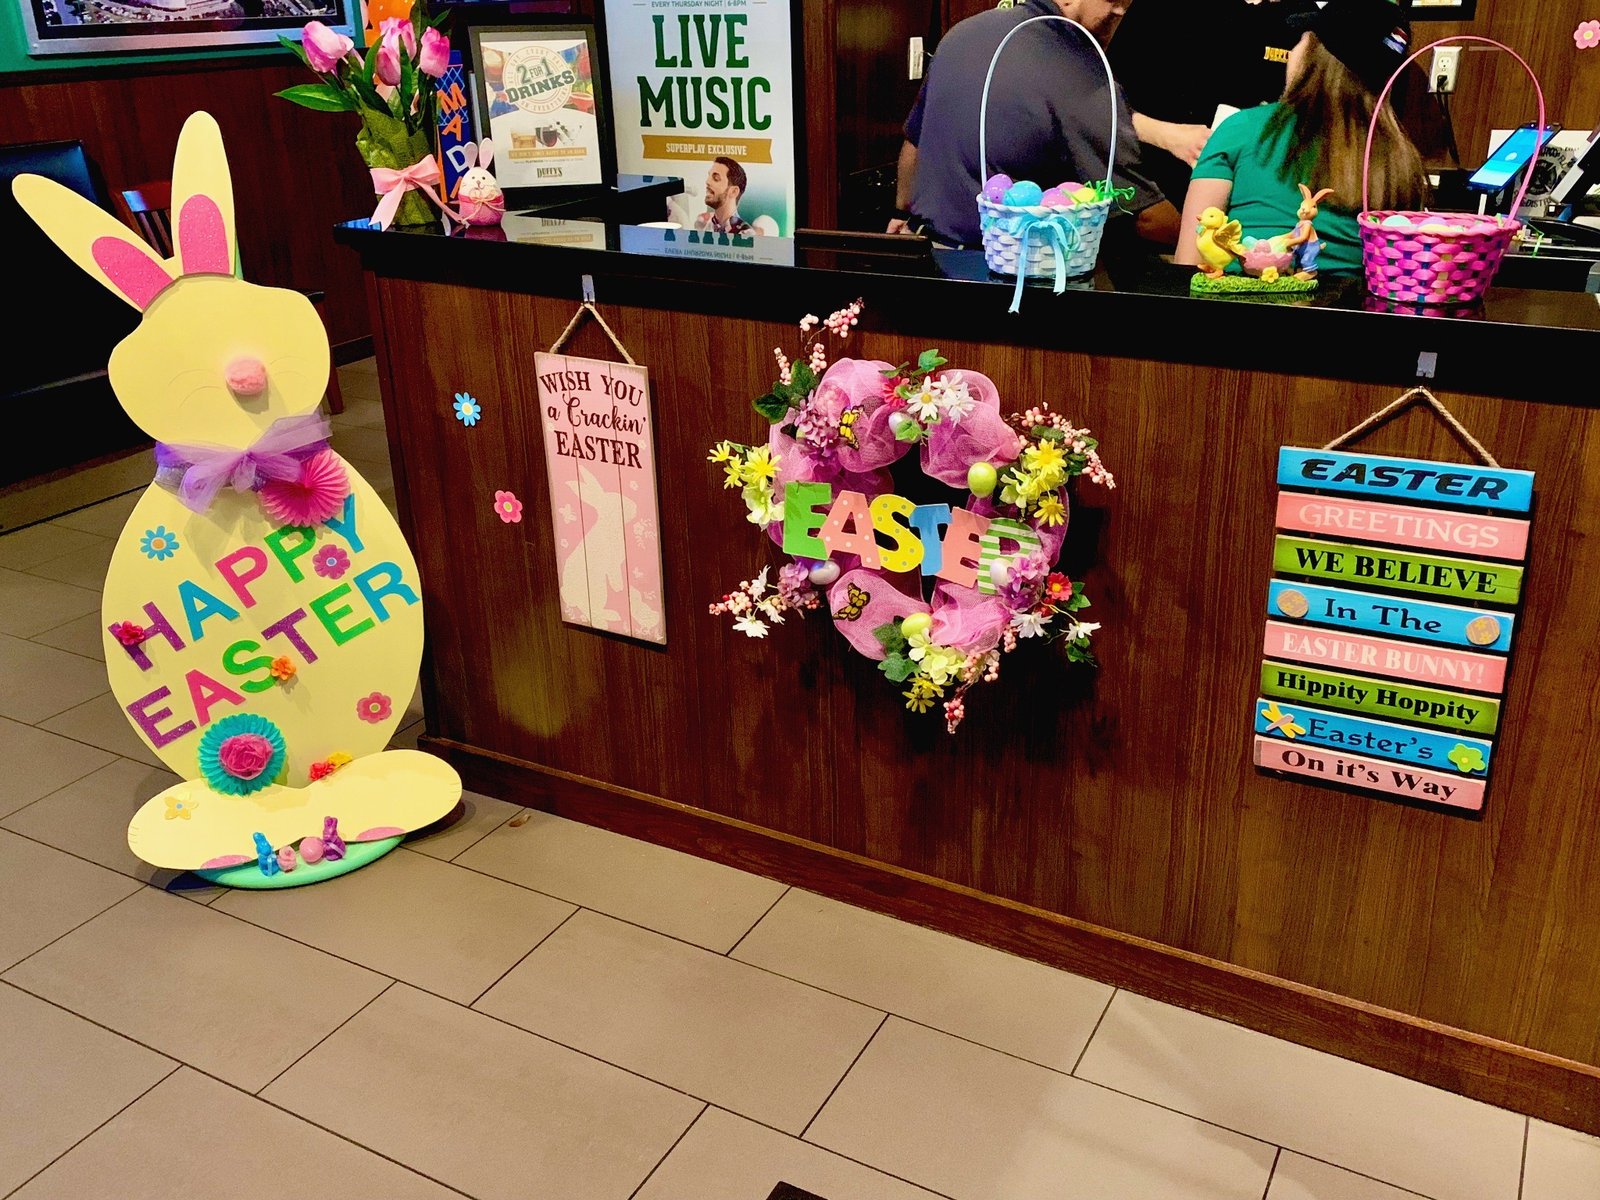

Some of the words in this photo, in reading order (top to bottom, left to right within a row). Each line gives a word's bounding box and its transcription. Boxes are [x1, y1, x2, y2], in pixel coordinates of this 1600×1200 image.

[651, 0, 670, 8] EVERY
[672, 0, 702, 8] THURSDAY
[652, 14, 749, 68] LIVE
[506, 70, 575, 103] DRINKS
[516, 64, 531, 84] 2
[529, 66, 544, 78] FOR
[541, 58, 553, 76] 1
[637, 76, 772, 131] MUSIC
[666, 142, 706, 154] SUPERPLAY
[708, 144, 748, 156] EXCLUSIVE
[540, 370, 592, 394] WISH
[600, 374, 644, 406] YOU
[548, 406, 560, 421] a
[562, 393, 646, 435] Crackin'
[554, 430, 642, 469] EASTER
[1300, 458, 1508, 500] EASTER
[1299, 504, 1500, 549] GREETINGS
[108, 493, 365, 672] HAPPY
[1296, 548, 1344, 575] WE
[1354, 555, 1498, 594] BELIEVE
[1325, 598, 1358, 620] In
[1372, 605, 1442, 634] The
[126, 561, 420, 750] EASTER
[1282, 631, 1378, 667] EASTER
[1384, 649, 1485, 684] BUNNY!
[1276, 671, 1368, 705] Hippity
[1376, 688, 1480, 724] Hoppity
[1308, 718, 1434, 760] Easter's
[1282, 750, 1324, 772] On
[1336, 760, 1379, 784] it's
[1392, 770, 1458, 801] Way
